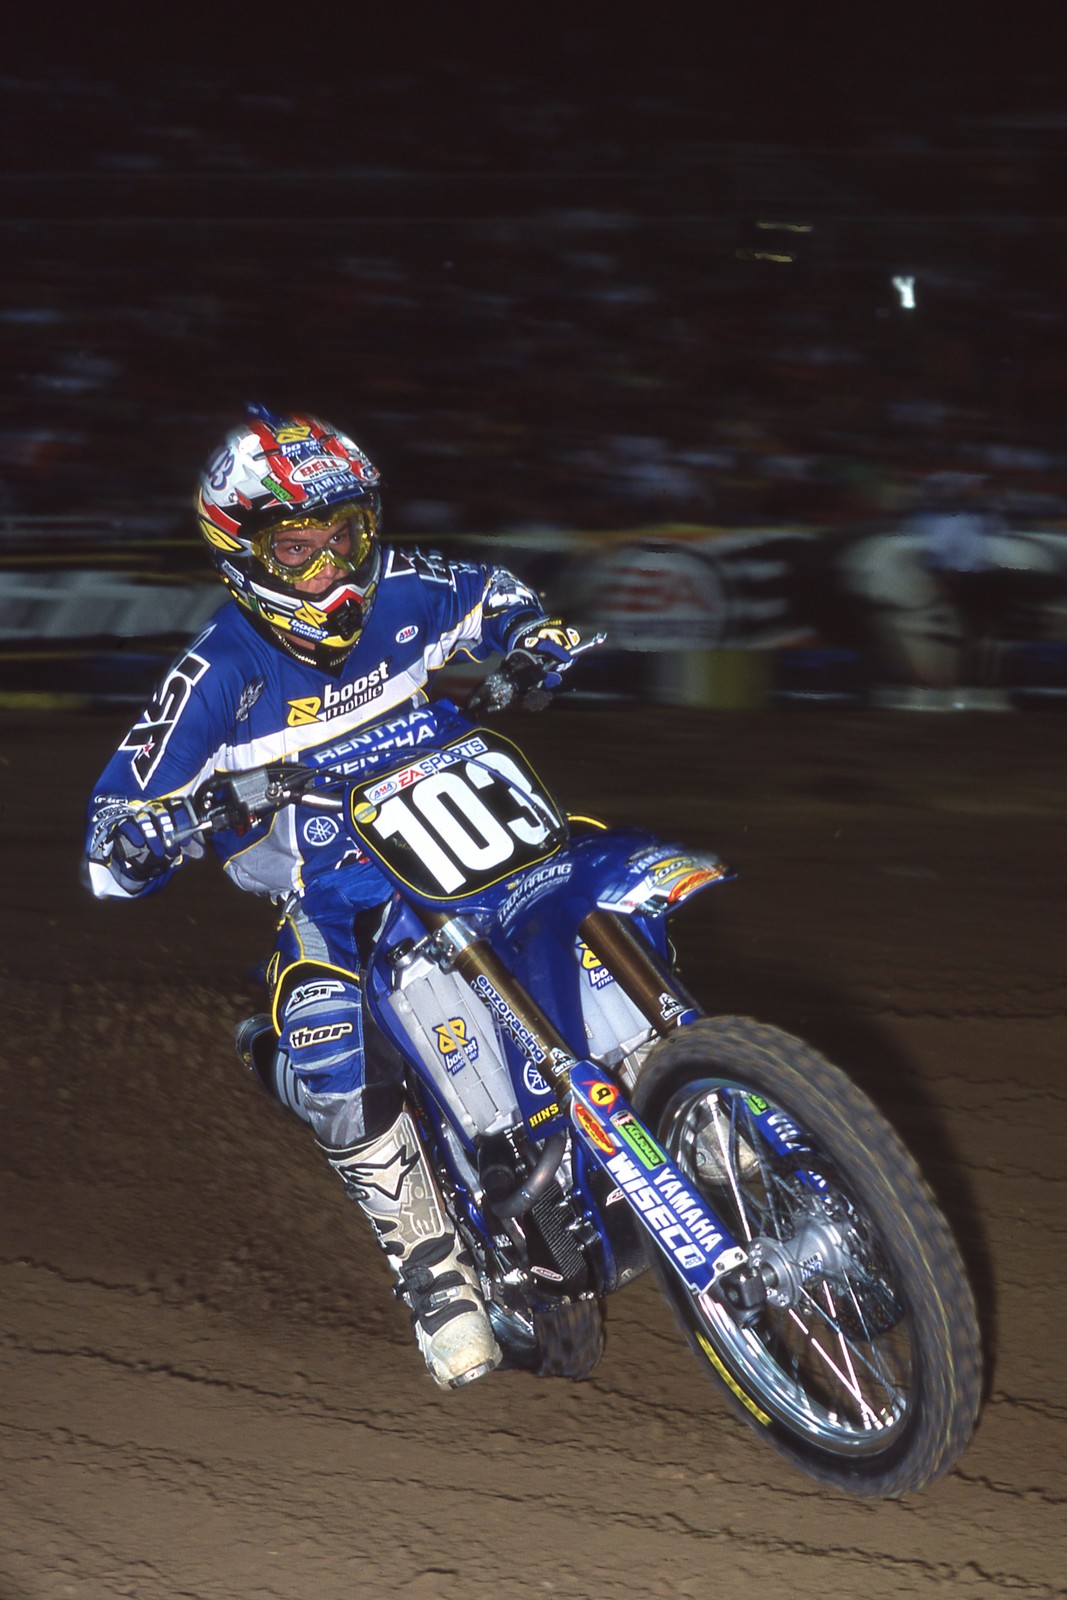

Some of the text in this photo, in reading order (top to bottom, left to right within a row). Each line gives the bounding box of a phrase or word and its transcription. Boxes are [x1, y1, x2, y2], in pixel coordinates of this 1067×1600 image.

[300, 460, 339, 477] BELL
[305, 471, 359, 494] YAMAHA
[290, 619, 329, 638] boost
[398, 626, 417, 642] AMA
[324, 660, 390, 708] boost
[326, 684, 384, 721] mobile
[313, 709, 434, 764] RENTHA
[325, 720, 438, 783] RENTHA
[374, 739, 485, 799] AMA EA SPORTS
[372, 752, 560, 895] 103
[290, 1024, 352, 1048] thor
[477, 975, 547, 1063] enzoracing
[529, 1103, 559, 1127] HINS
[606, 1151, 706, 1269] WISECO
[654, 1167, 723, 1252] YAMAHA
